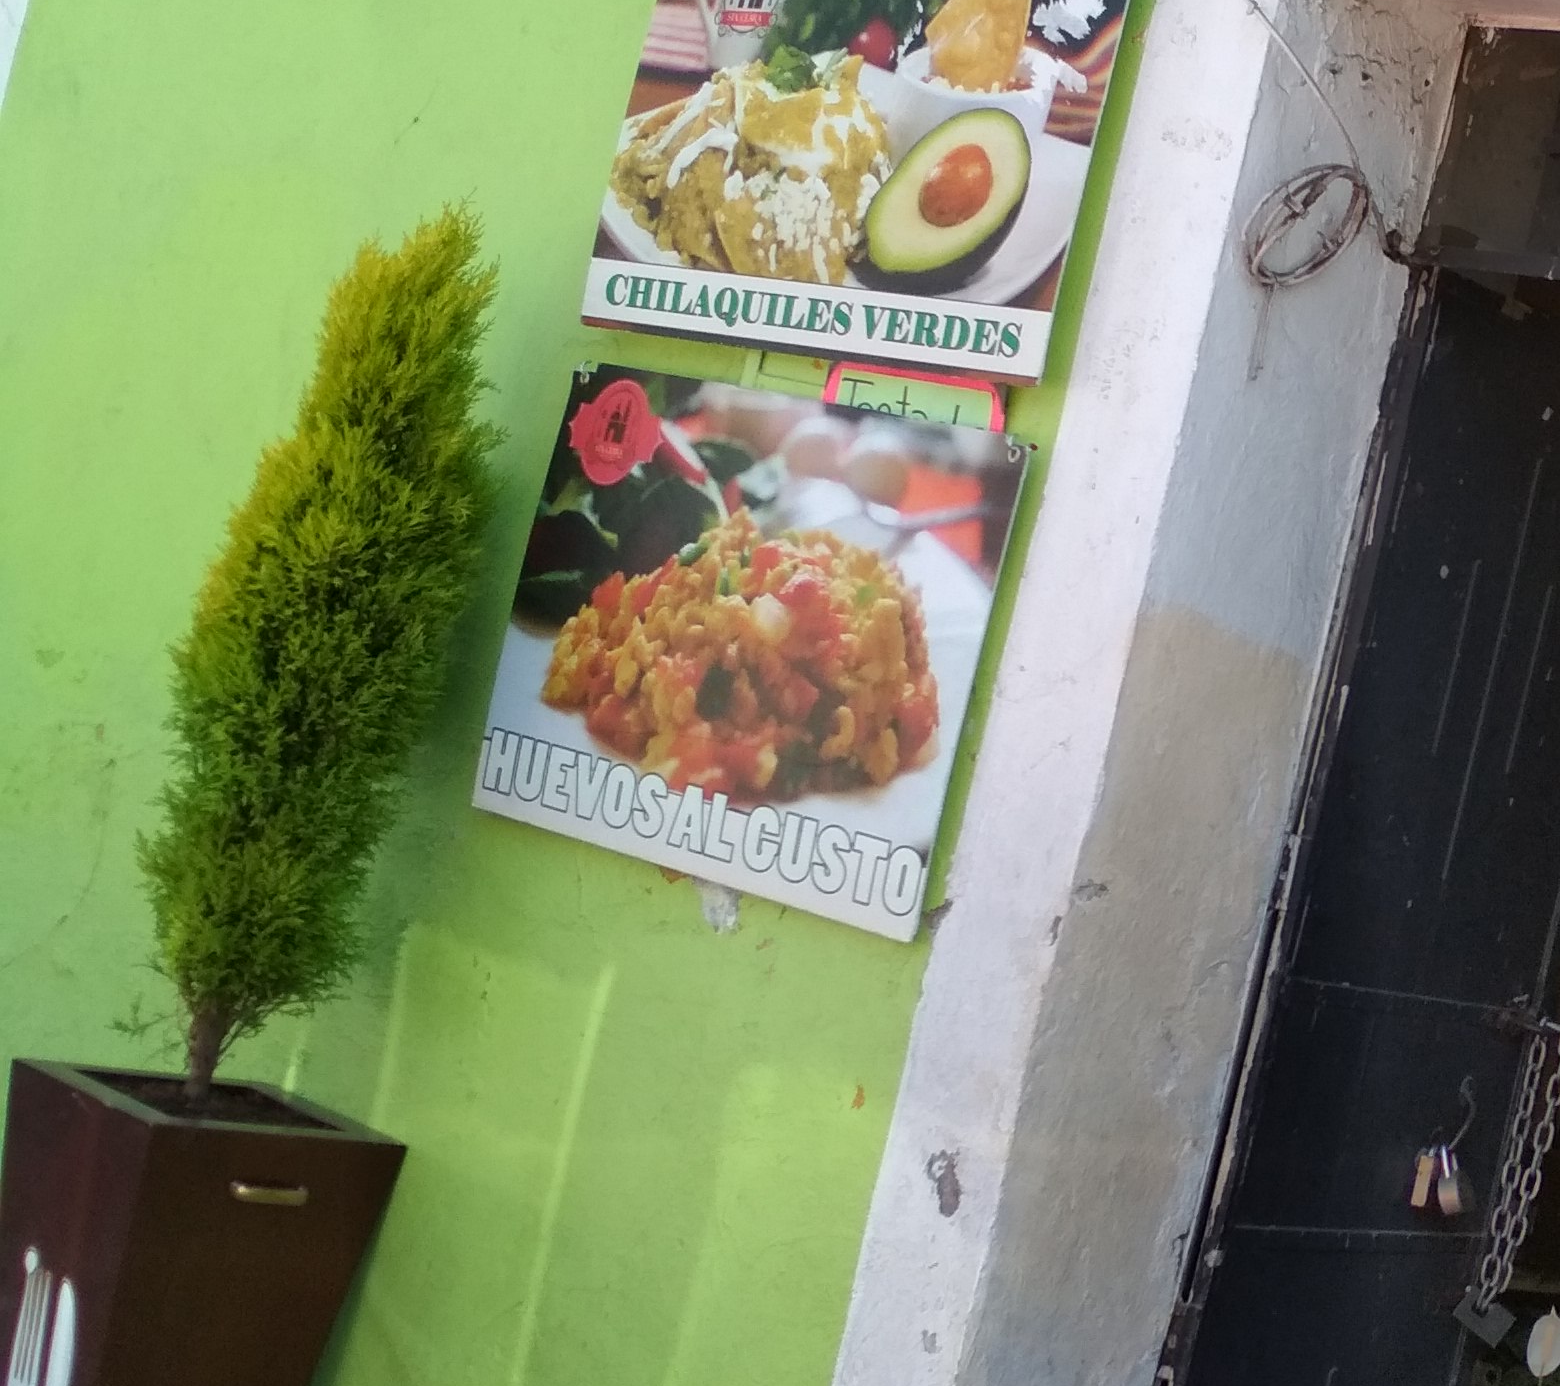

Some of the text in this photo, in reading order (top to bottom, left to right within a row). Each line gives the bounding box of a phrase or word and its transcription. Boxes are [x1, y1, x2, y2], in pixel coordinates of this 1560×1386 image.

[605, 273, 1023, 359] CHILAQUILES VERDES
[482, 727, 668, 839] HUEVOS
[667, 784, 736, 863] AL
